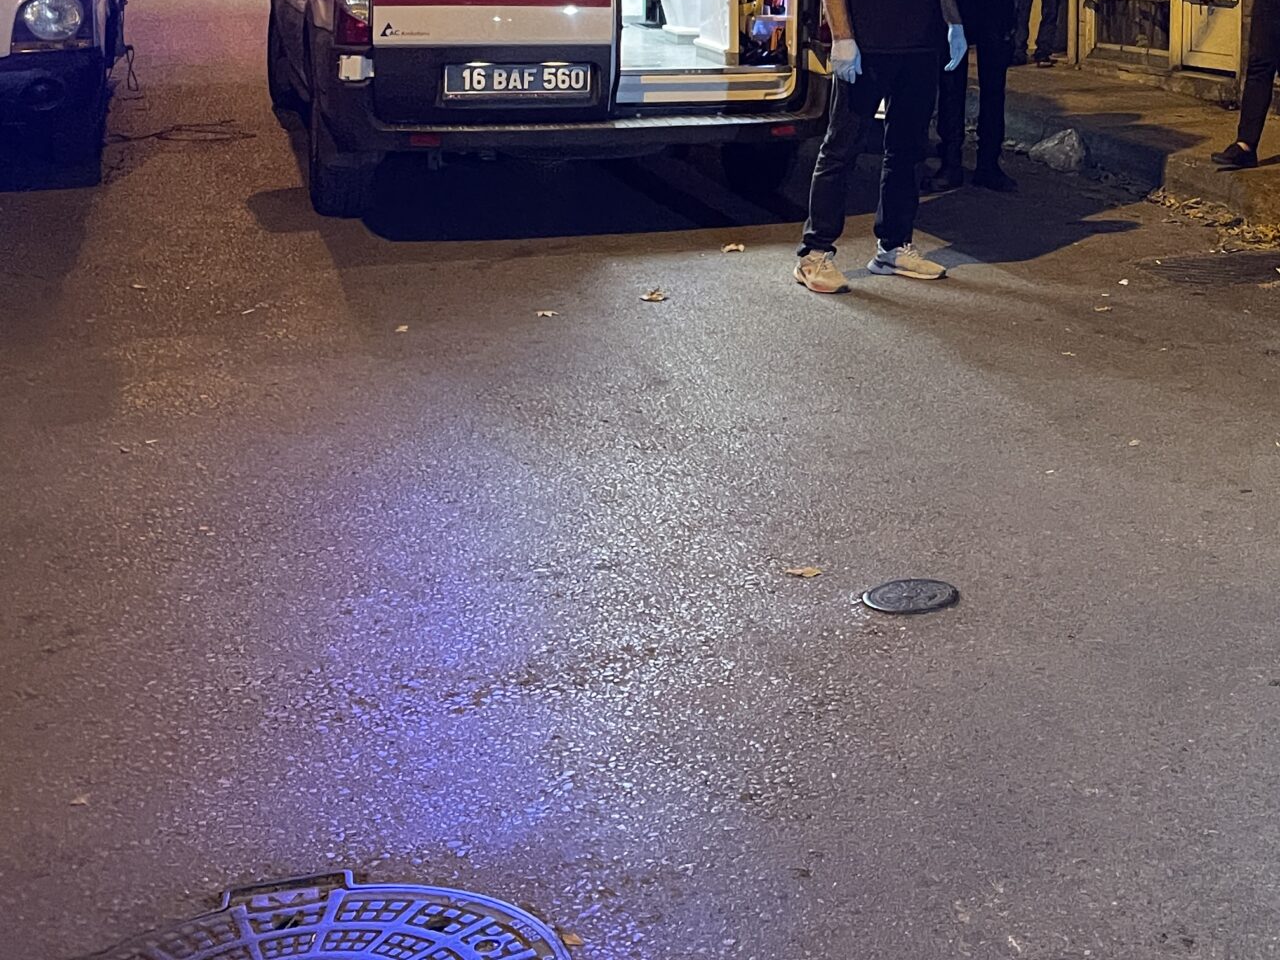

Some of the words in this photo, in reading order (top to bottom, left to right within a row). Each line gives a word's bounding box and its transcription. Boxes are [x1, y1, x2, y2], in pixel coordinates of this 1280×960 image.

[462, 68, 486, 90] 16
[493, 68, 537, 90] BAF
[543, 68, 585, 90] 560
